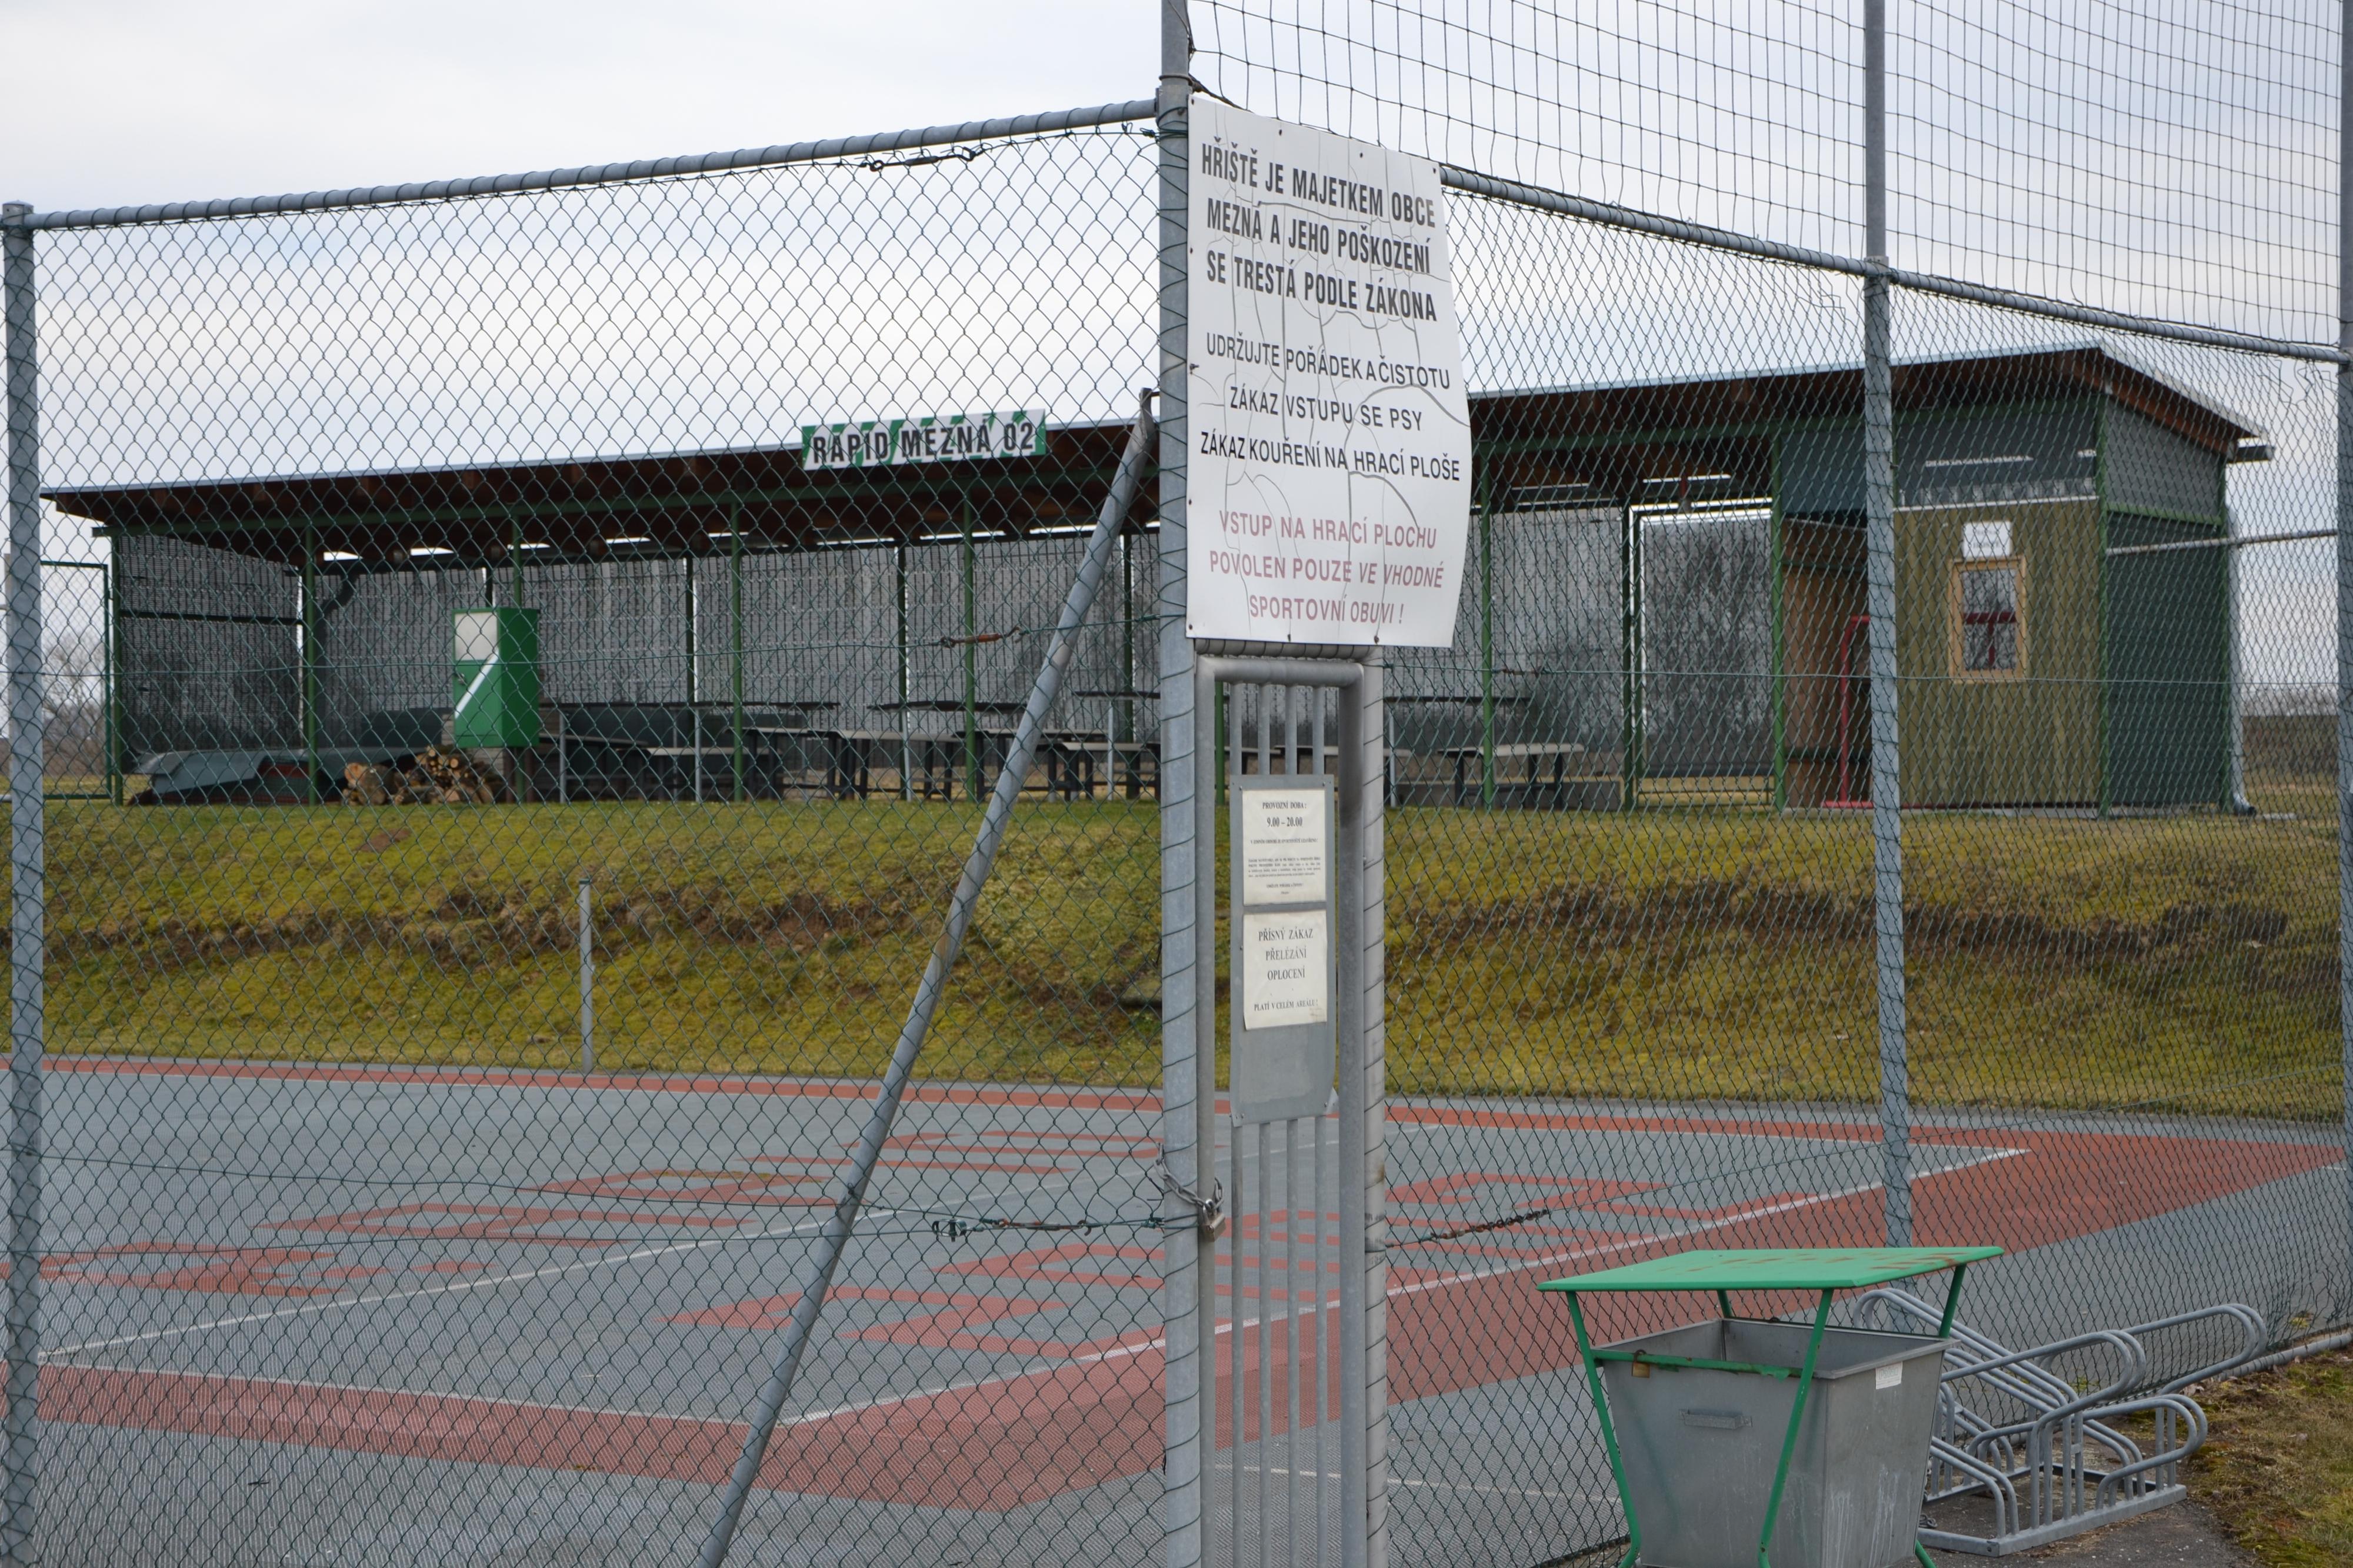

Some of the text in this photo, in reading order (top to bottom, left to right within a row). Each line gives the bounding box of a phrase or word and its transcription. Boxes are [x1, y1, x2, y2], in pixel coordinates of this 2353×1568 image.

[1202, 136, 1435, 228] HŘIŠTĚ JE MAJETKEM OBCE
[1207, 198, 1430, 273] MEZNÁ A JEHO POŠKOZENÍ
[1207, 250, 1437, 321] SE TRESTÁ PODLE ZÁKONA
[1207, 331, 1450, 389] UDRŽUJTE POŘÁDEK A ČISTOTU
[1230, 383, 1422, 431] ZÁKAZ VSTUPU SE PSY
[812, 419, 1034, 463] RAPID MEZNÁ 02
[1201, 429, 1460, 481] ZÁKAZ KOUŘENÍ NA HRACÍ PLOŠE
[1219, 510, 1437, 549] VSTUP NA HRACÍ PLOCHU
[1210, 551, 1444, 588] POVOLEN POUZE VE VHODNÉ
[1249, 594, 1347, 622] SPORTOVNÍ
[1262, 800, 1288, 809] PROVOZNÍ
[1267, 817, 1279, 827] 9.00
[1287, 817, 1303, 826] 20.00
[1259, 927, 1313, 941] PŘÍSNÝ ZÁKAZ
[1266, 946, 1307, 961] PŘELÉZÁNÍ
[1268, 966, 1305, 980] OPLOCENÍ
[1254, 1001, 1269, 1011] PLATÍ
[1277, 1000, 1294, 1009] CELÉM
